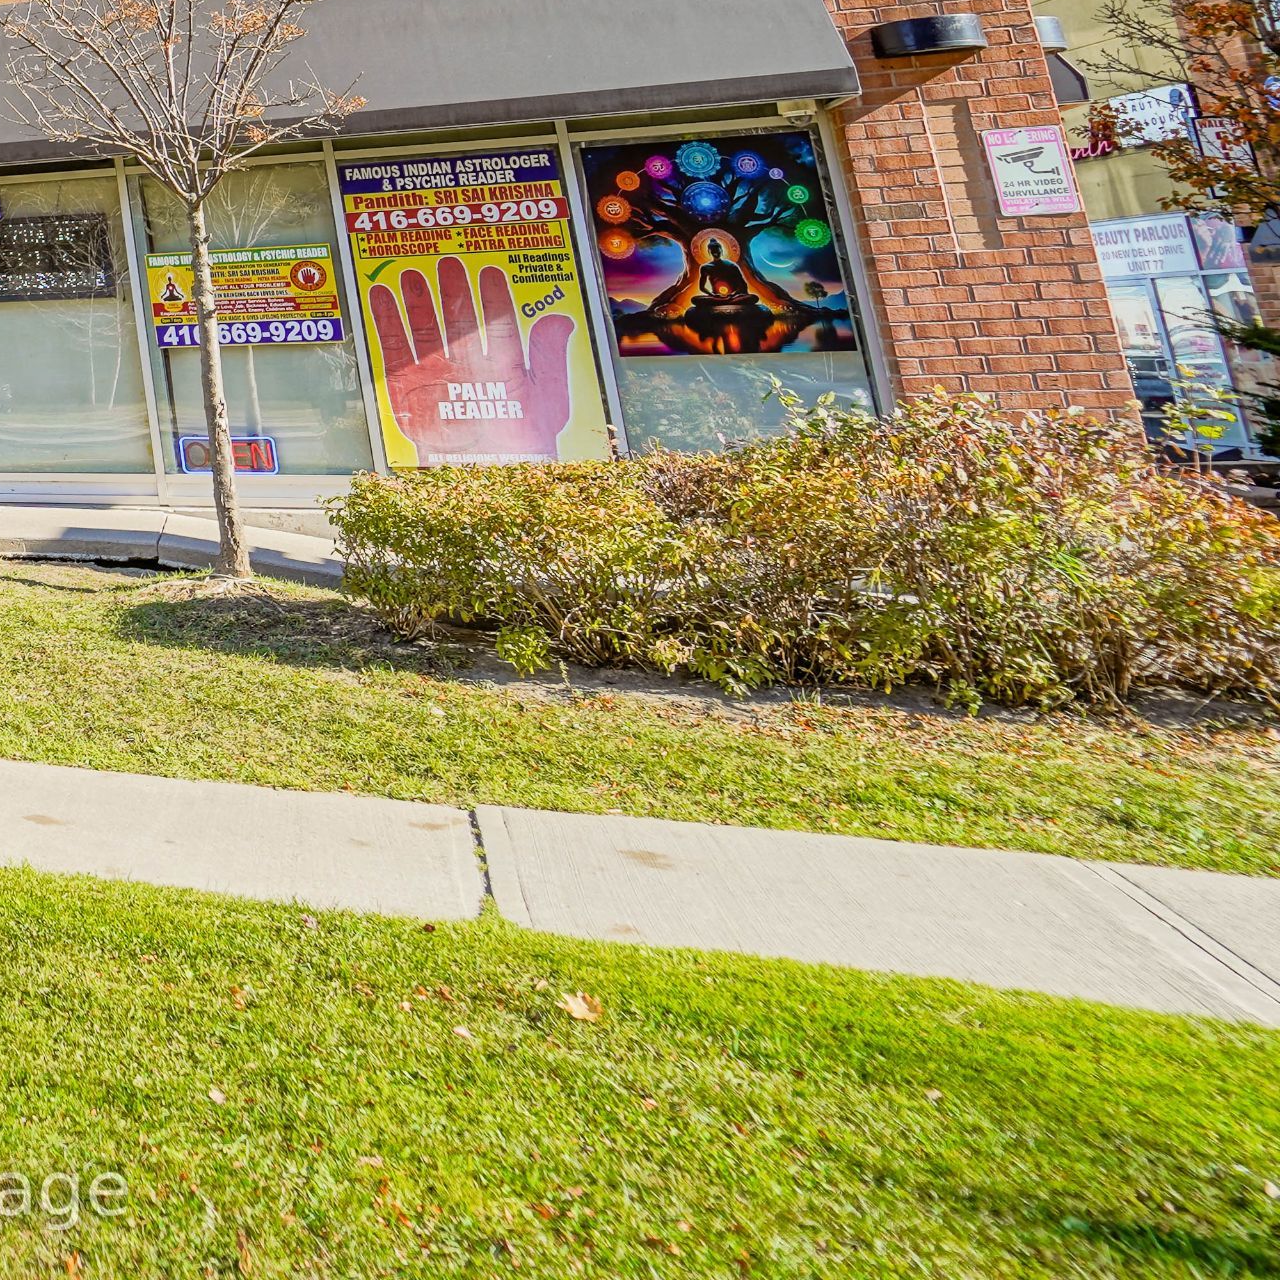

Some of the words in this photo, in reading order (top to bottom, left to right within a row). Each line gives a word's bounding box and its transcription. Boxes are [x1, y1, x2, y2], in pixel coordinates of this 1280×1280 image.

[988, 134, 1002, 145] NO
[1004, 129, 1056, 145] LOERING
[345, 165, 400, 181] FAMOUS
[403, 161, 451, 176] INDIAN
[455, 153, 551, 173] ASTROLOGER
[382, 178, 392, 191] &
[396, 173, 456, 190] PSYCHIC
[460, 170, 516, 186] READER
[1033, 178, 1064, 186] VIDEO
[353, 193, 429, 209] Pandith:
[434, 190, 459, 204] SRI
[463, 188, 485, 203] SAI
[489, 183, 555, 201] KRISHNA
[1003, 187, 1070, 198] SURVILLANCE
[354, 198, 558, 231] 416-669-9209
[366, 234, 398, 244] PALM
[400, 229, 452, 243] READING
[463, 226, 493, 238] FACE
[495, 223, 550, 237] READING
[1133, 223, 1187, 242] PARLOUR
[368, 241, 440, 256] HOROSCOPE
[465, 238, 505, 251] PATRA
[508, 235, 563, 249] READING
[1101, 251, 1111, 260] 20
[1112, 248, 1131, 258] NEW
[1132, 246, 1156, 258] DELHI
[1158, 244, 1185, 256] DRIVE
[148, 256, 181, 267] FAMOUS
[209, 251, 252, 265] ASTROLOGY
[261, 249, 297, 260] PSYCHIC
[297, 247, 328, 258] READER
[508, 254, 521, 264] All
[523, 253, 571, 263] Readings
[1128, 260, 1151, 272] UNIT
[1152, 259, 1165, 270] 77
[512, 272, 574, 284] Confidential
[518, 263, 554, 273] Private
[556, 263, 564, 272] &
[521, 284, 565, 318] Good
[163, 319, 334, 346] 41669-9209
[447, 381, 507, 401] PALM
[438, 400, 524, 420] READER
[185, 441, 273, 470] OEN
